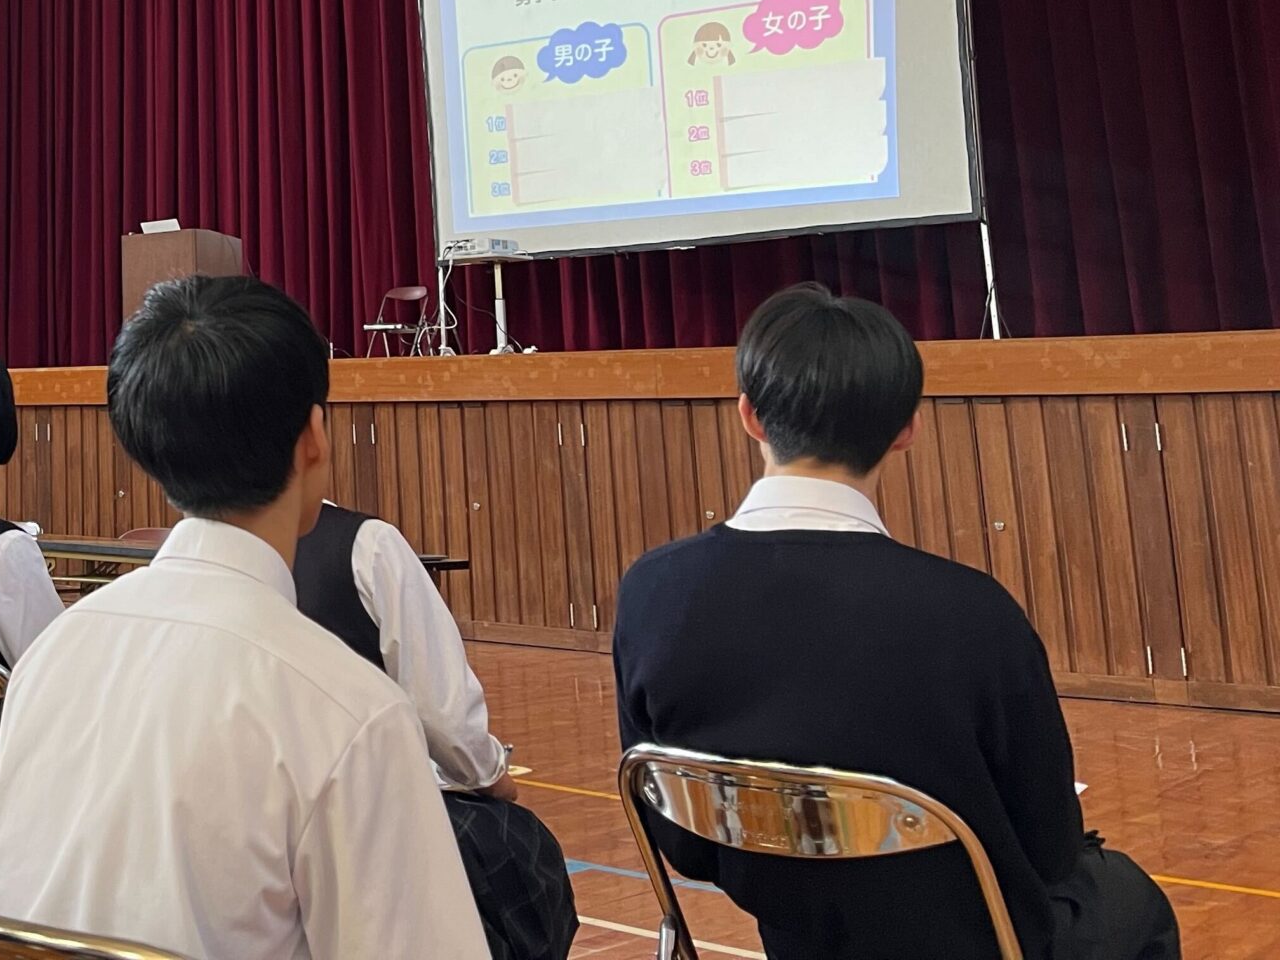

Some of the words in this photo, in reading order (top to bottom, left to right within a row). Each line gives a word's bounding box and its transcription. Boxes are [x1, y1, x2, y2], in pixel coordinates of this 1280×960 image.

[762, 5, 831, 37] 女の子
[554, 38, 614, 68] 男の子
